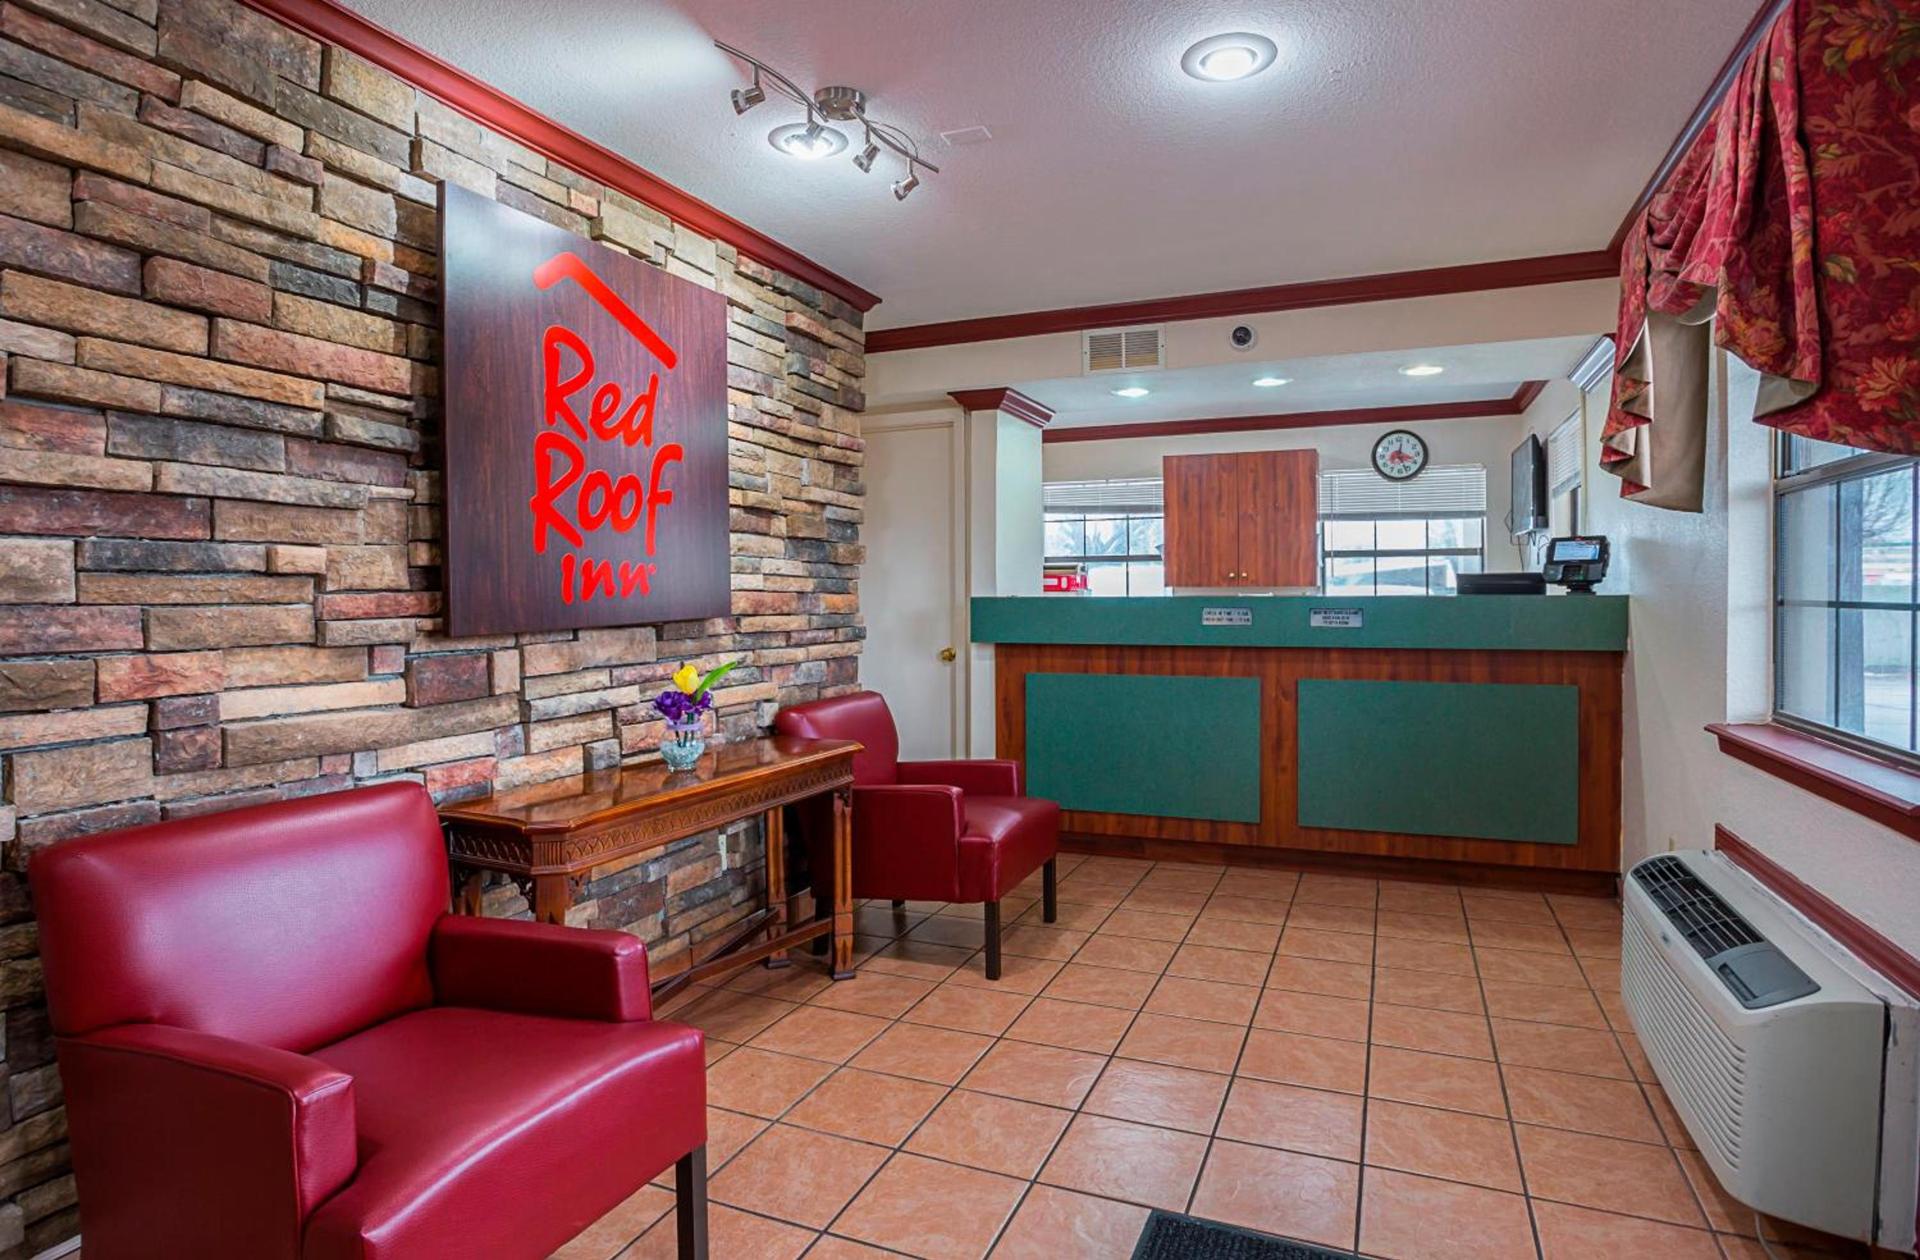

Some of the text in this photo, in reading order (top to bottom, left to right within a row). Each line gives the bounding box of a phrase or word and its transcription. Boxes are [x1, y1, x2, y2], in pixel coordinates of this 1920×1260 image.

[542, 325, 660, 449] Red
[530, 431, 684, 556] Roof
[560, 552, 652, 606] Inn
